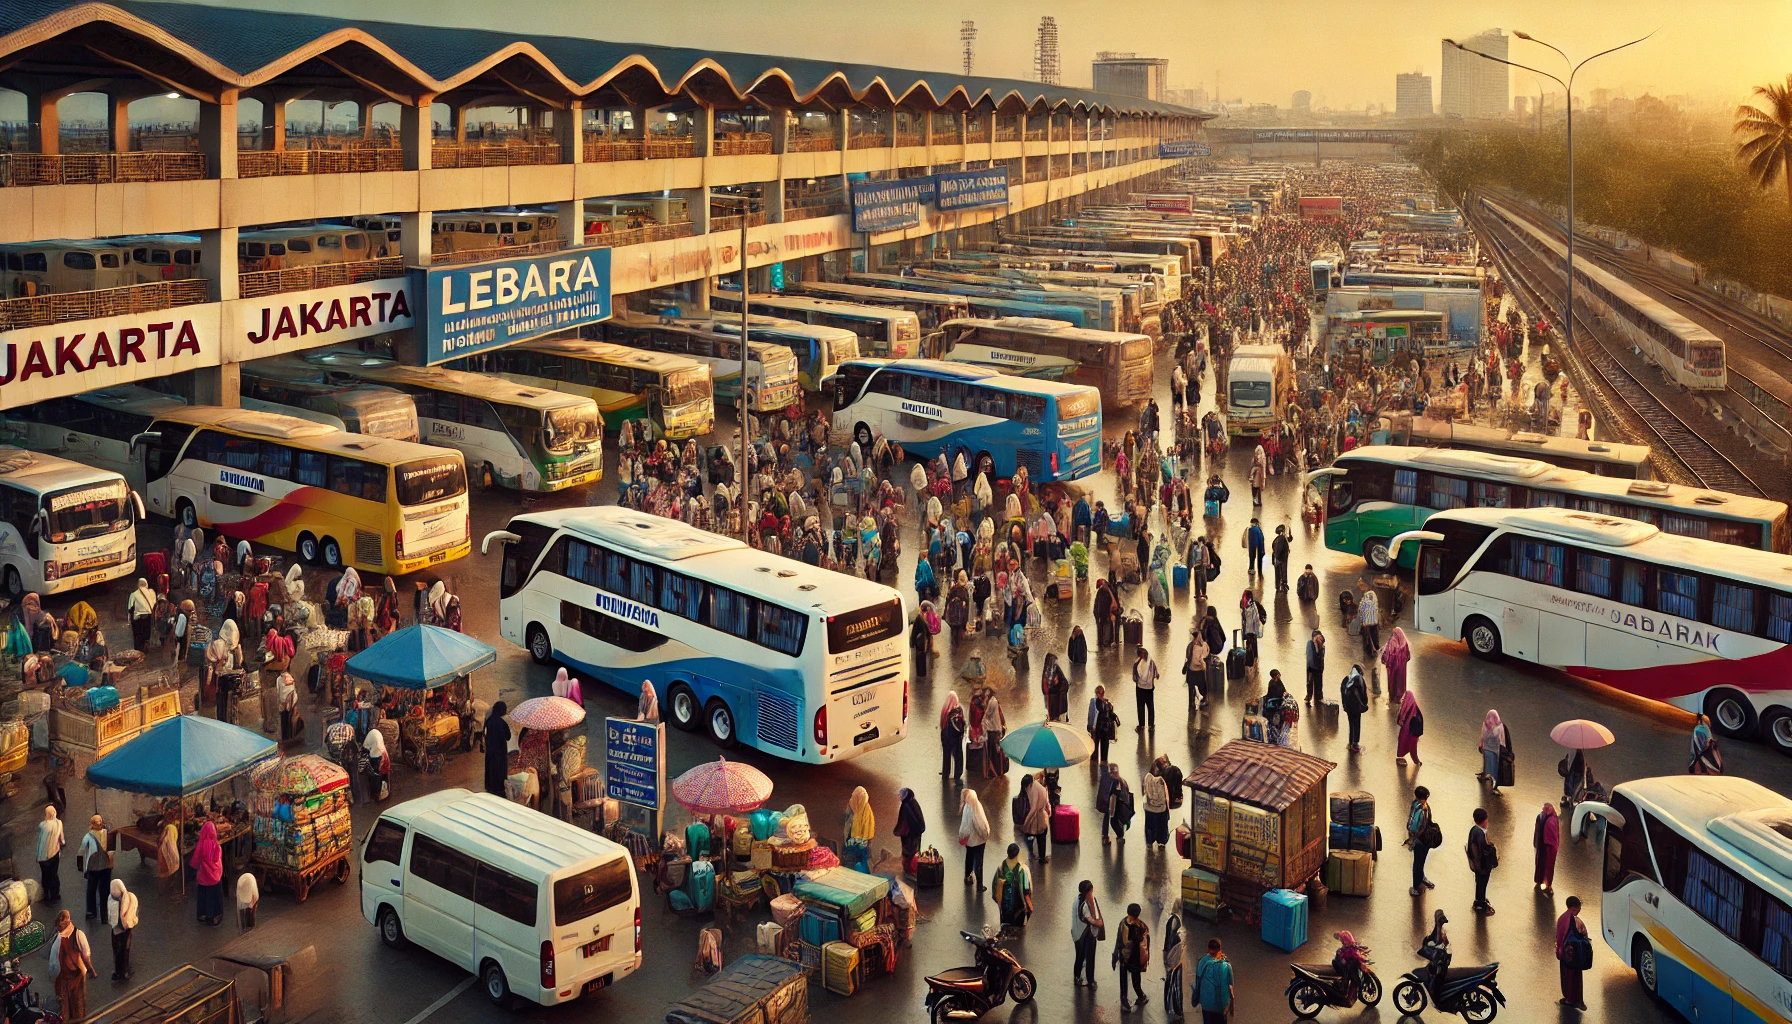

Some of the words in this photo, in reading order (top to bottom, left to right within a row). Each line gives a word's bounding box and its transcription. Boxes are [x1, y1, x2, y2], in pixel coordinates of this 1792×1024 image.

[442, 256, 599, 315] LEBARA
[247, 290, 411, 344] JAKARTA
[0, 320, 200, 386] JAKARTA
